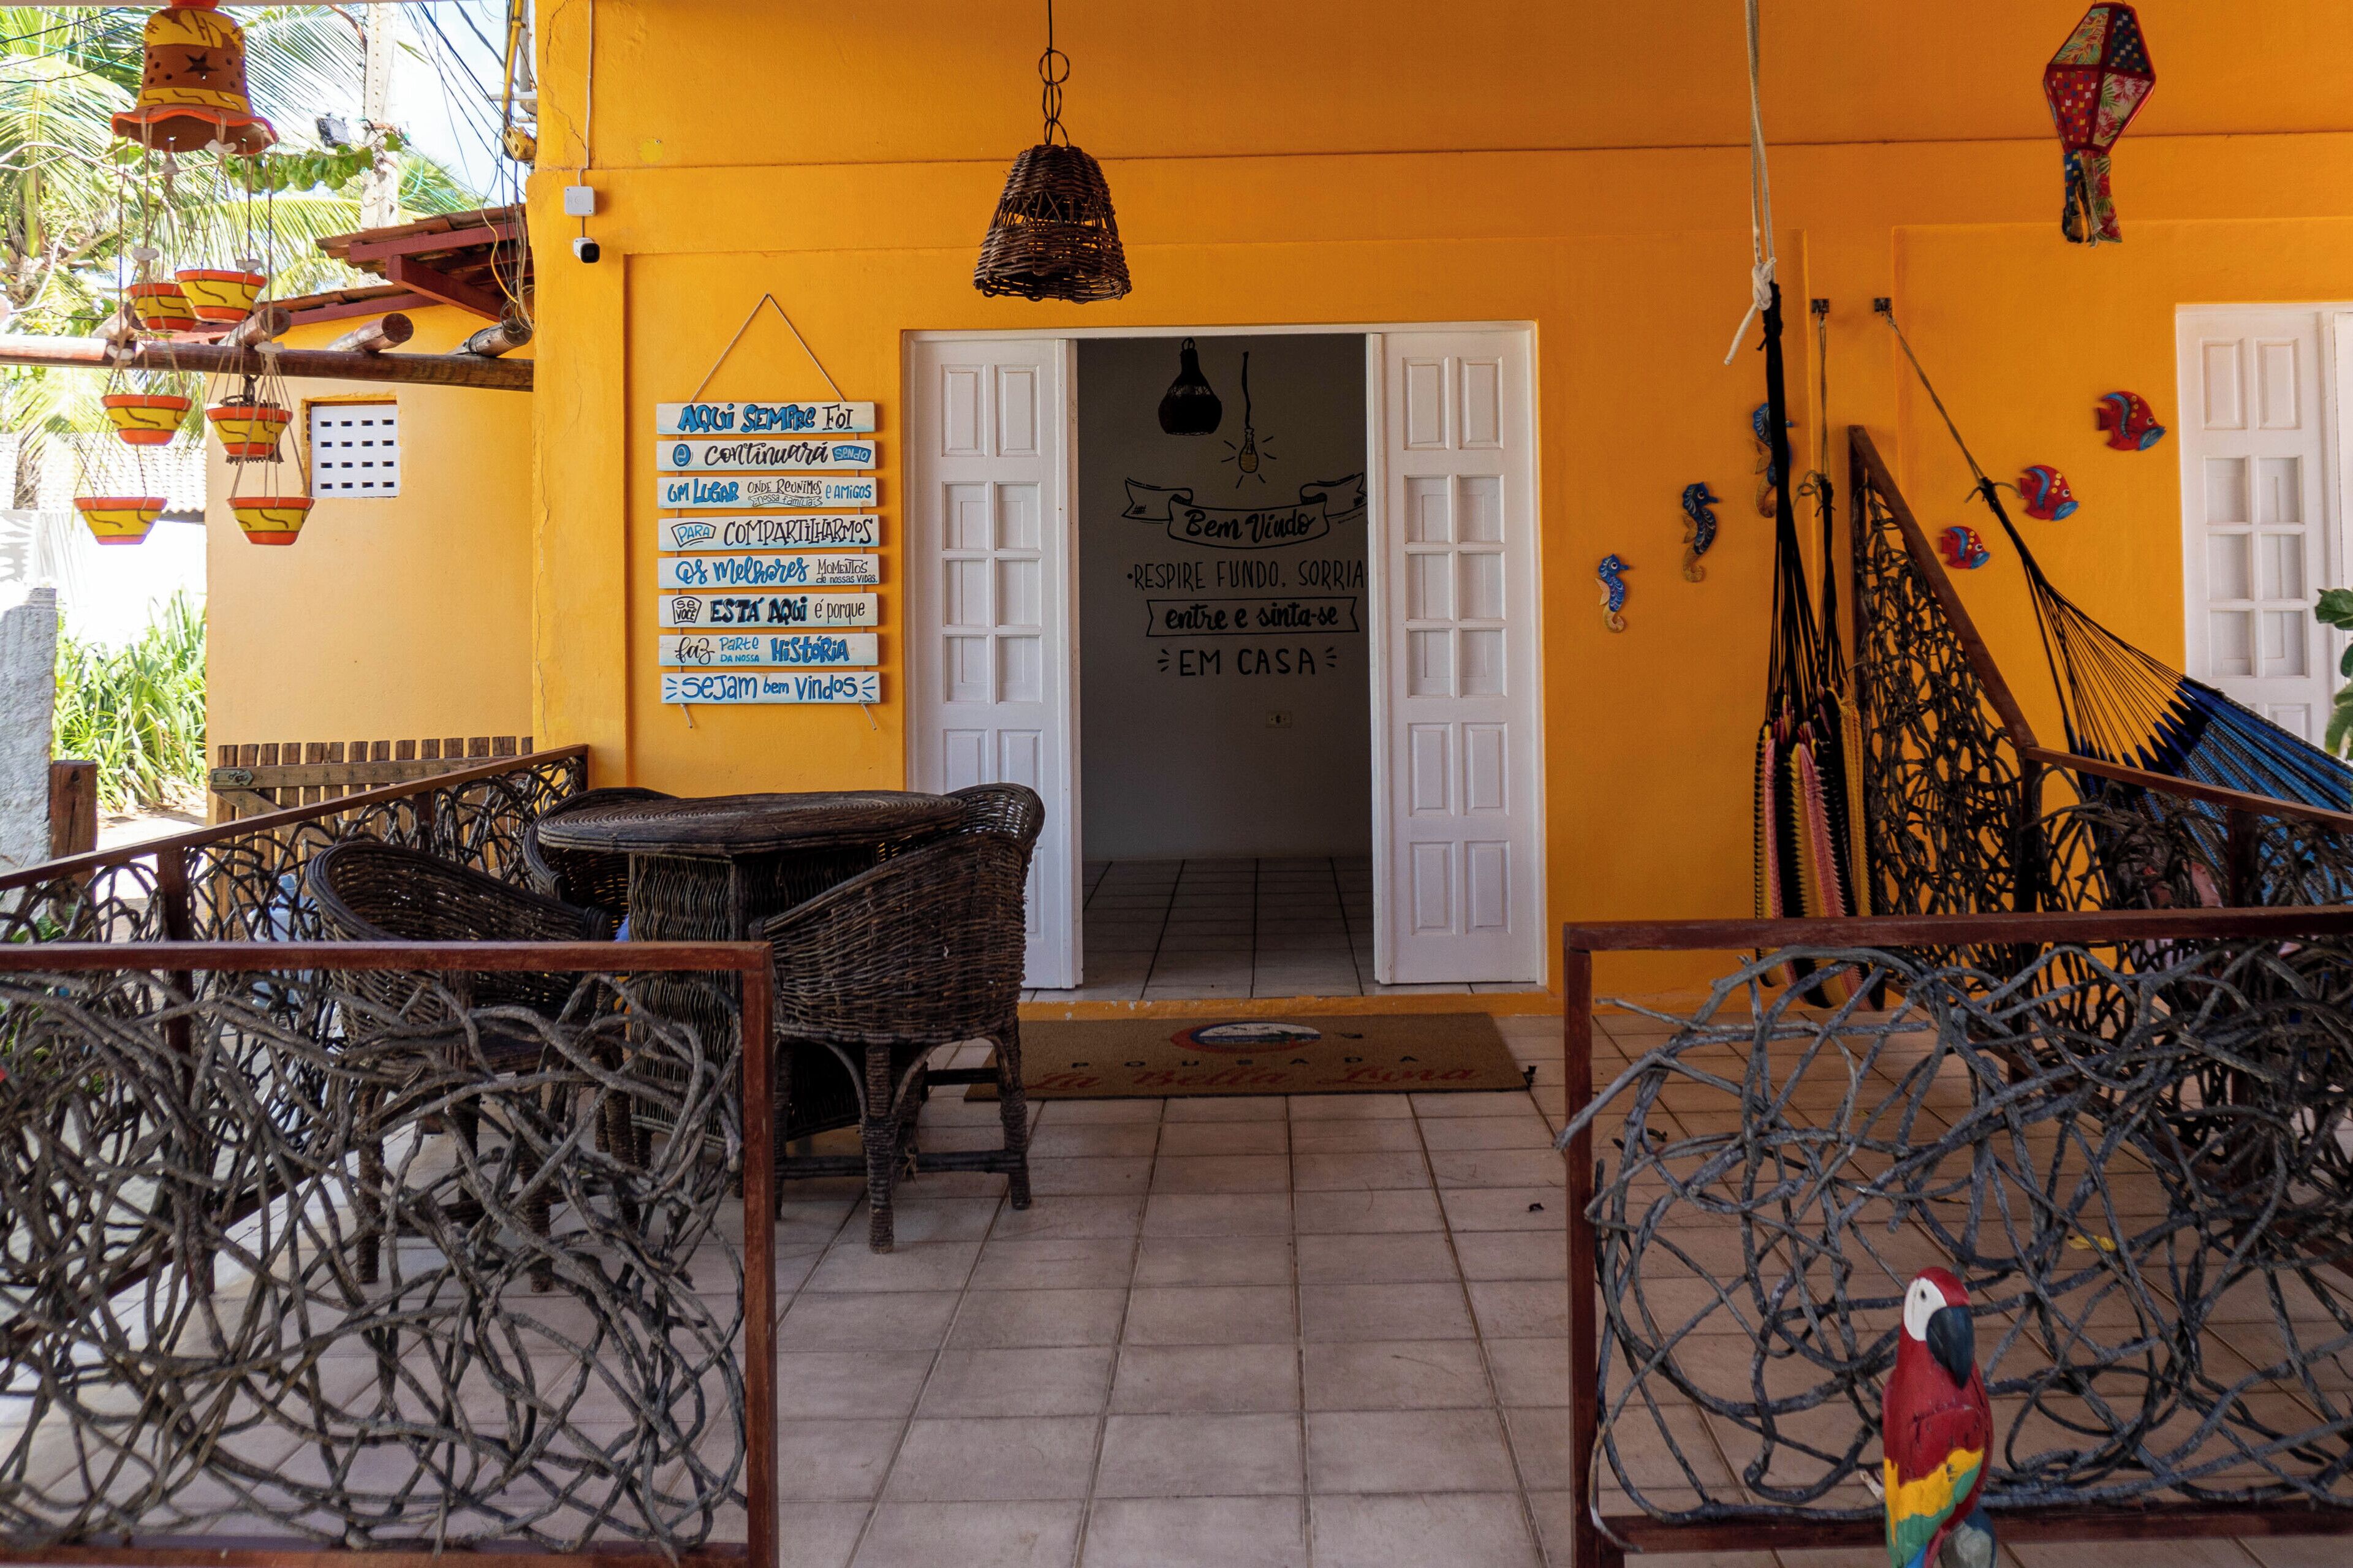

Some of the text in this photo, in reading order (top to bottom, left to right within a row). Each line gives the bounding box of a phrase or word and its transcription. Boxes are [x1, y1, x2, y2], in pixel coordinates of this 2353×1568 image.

[705, 441, 828, 466] continuará
[667, 478, 740, 504] UM LUGAR
[747, 479, 772, 494] ONDE
[757, 494, 779, 503] nossa
[825, 485, 832, 499] e
[677, 525, 710, 543] PARA
[1184, 508, 1317, 543] Bem Vindo
[816, 573, 827, 583] de
[1134, 561, 1206, 592] RESPIRE
[1298, 559, 1364, 590] SORRIA
[676, 600, 695, 609] se
[710, 597, 765, 623] ESTÁ
[814, 599, 824, 618] é
[827, 602, 865, 625] porque
[1166, 602, 1339, 631] entre e sinta-se
[675, 637, 715, 665] faz
[1179, 648, 1316, 676] EM CASA
[763, 676, 790, 695] bem
